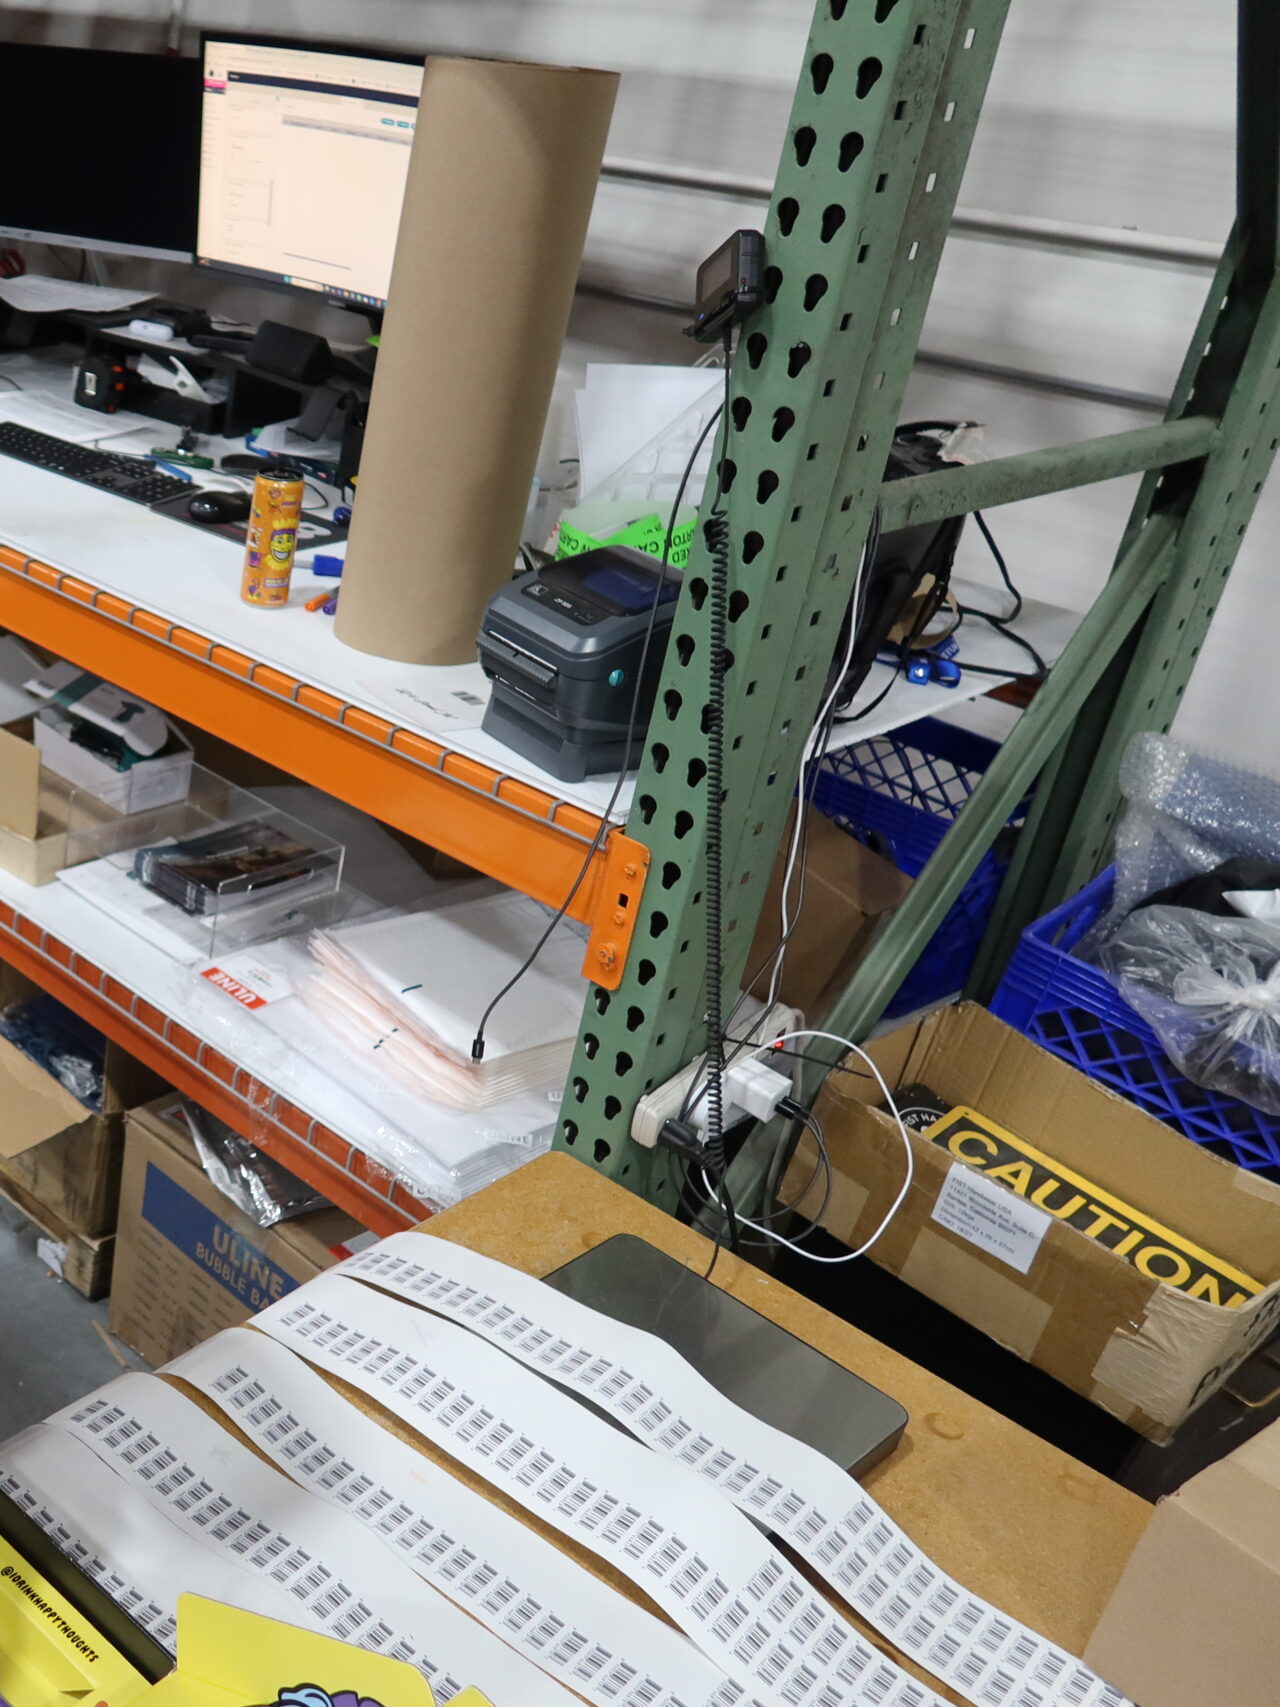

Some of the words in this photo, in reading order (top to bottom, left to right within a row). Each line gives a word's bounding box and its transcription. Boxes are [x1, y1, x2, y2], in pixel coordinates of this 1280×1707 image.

[208, 971, 257, 1004] ULINE
[948, 1130, 1248, 1310] CAUTION
[195, 1241, 246, 1295] BUBBLE
[251, 1287, 271, 1310] BA
[213, 1224, 285, 1300] ULINE
[0, 1566, 100, 1663] @IDRINKHAPPYTHOUGHTS
